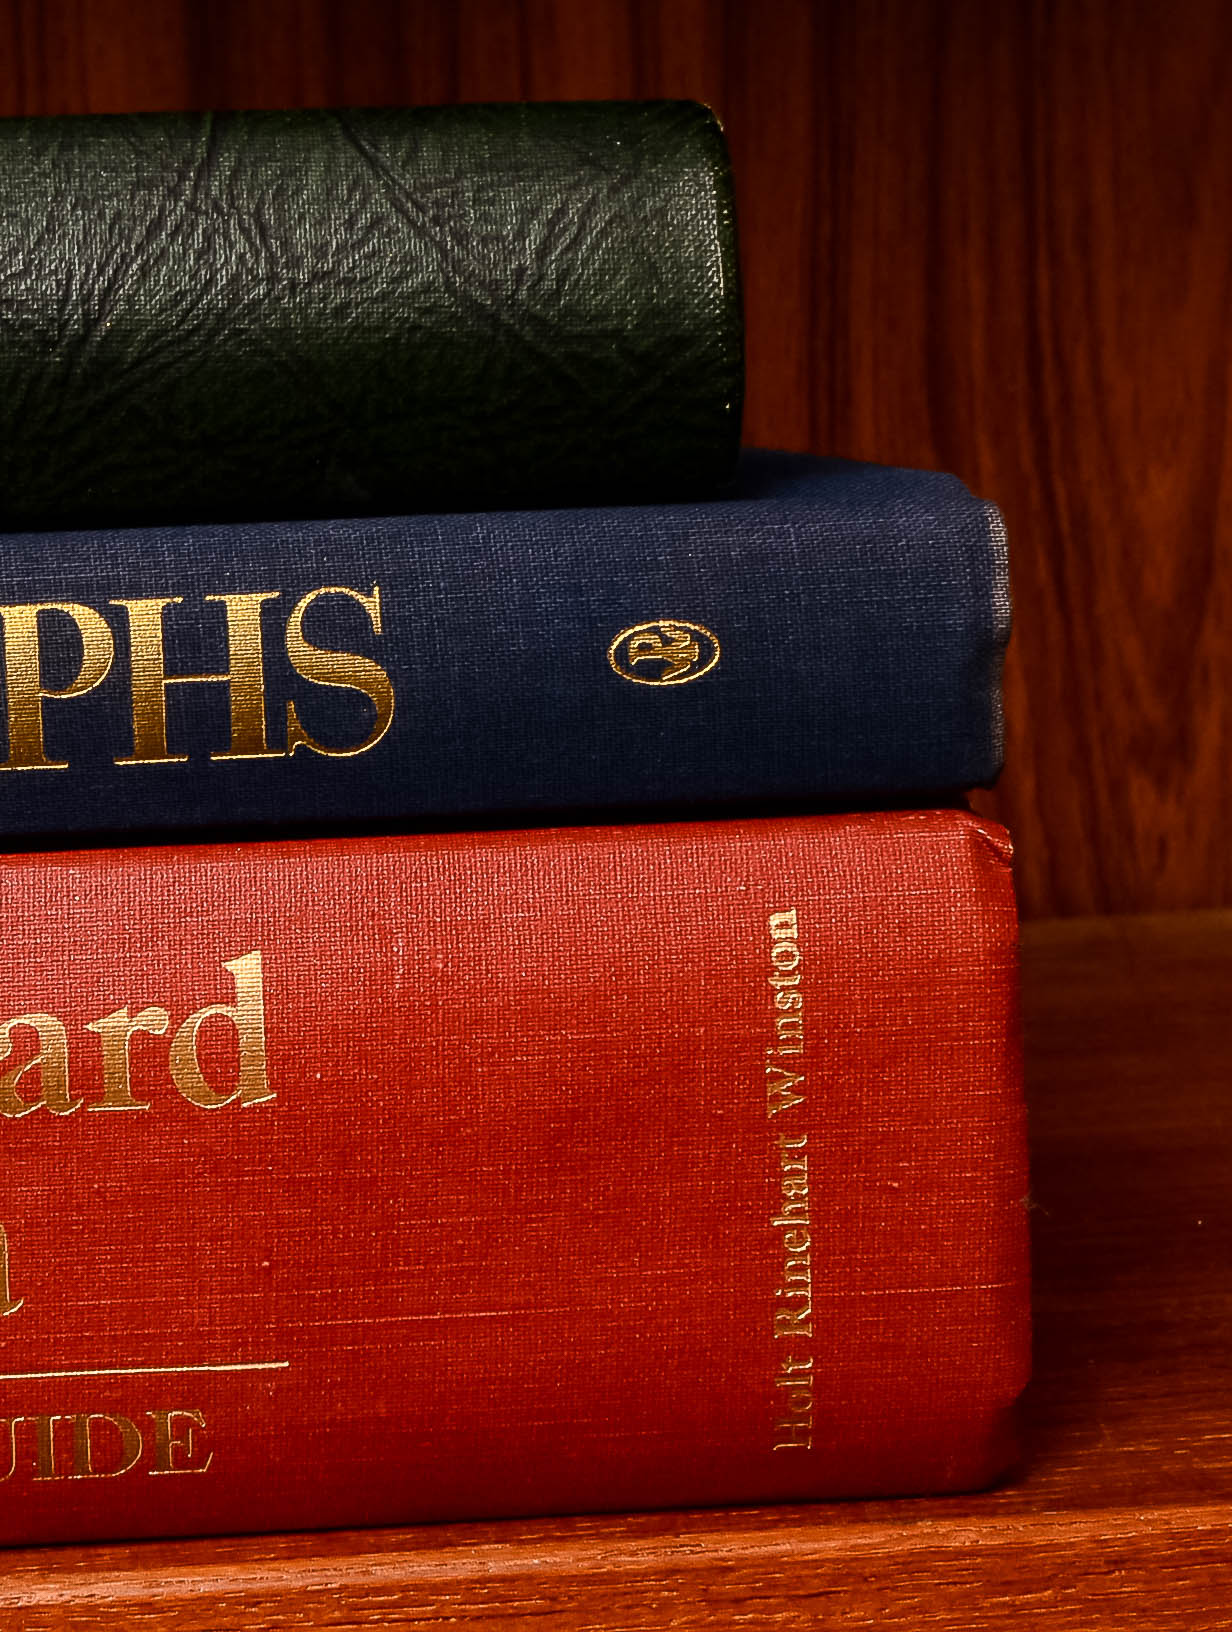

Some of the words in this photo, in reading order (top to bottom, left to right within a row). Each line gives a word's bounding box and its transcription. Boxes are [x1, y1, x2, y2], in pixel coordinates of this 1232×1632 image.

[765, 908, 807, 1120] Winston
[771, 1133, 813, 1340] Rinehart
[772, 1355, 814, 1452] Holt
